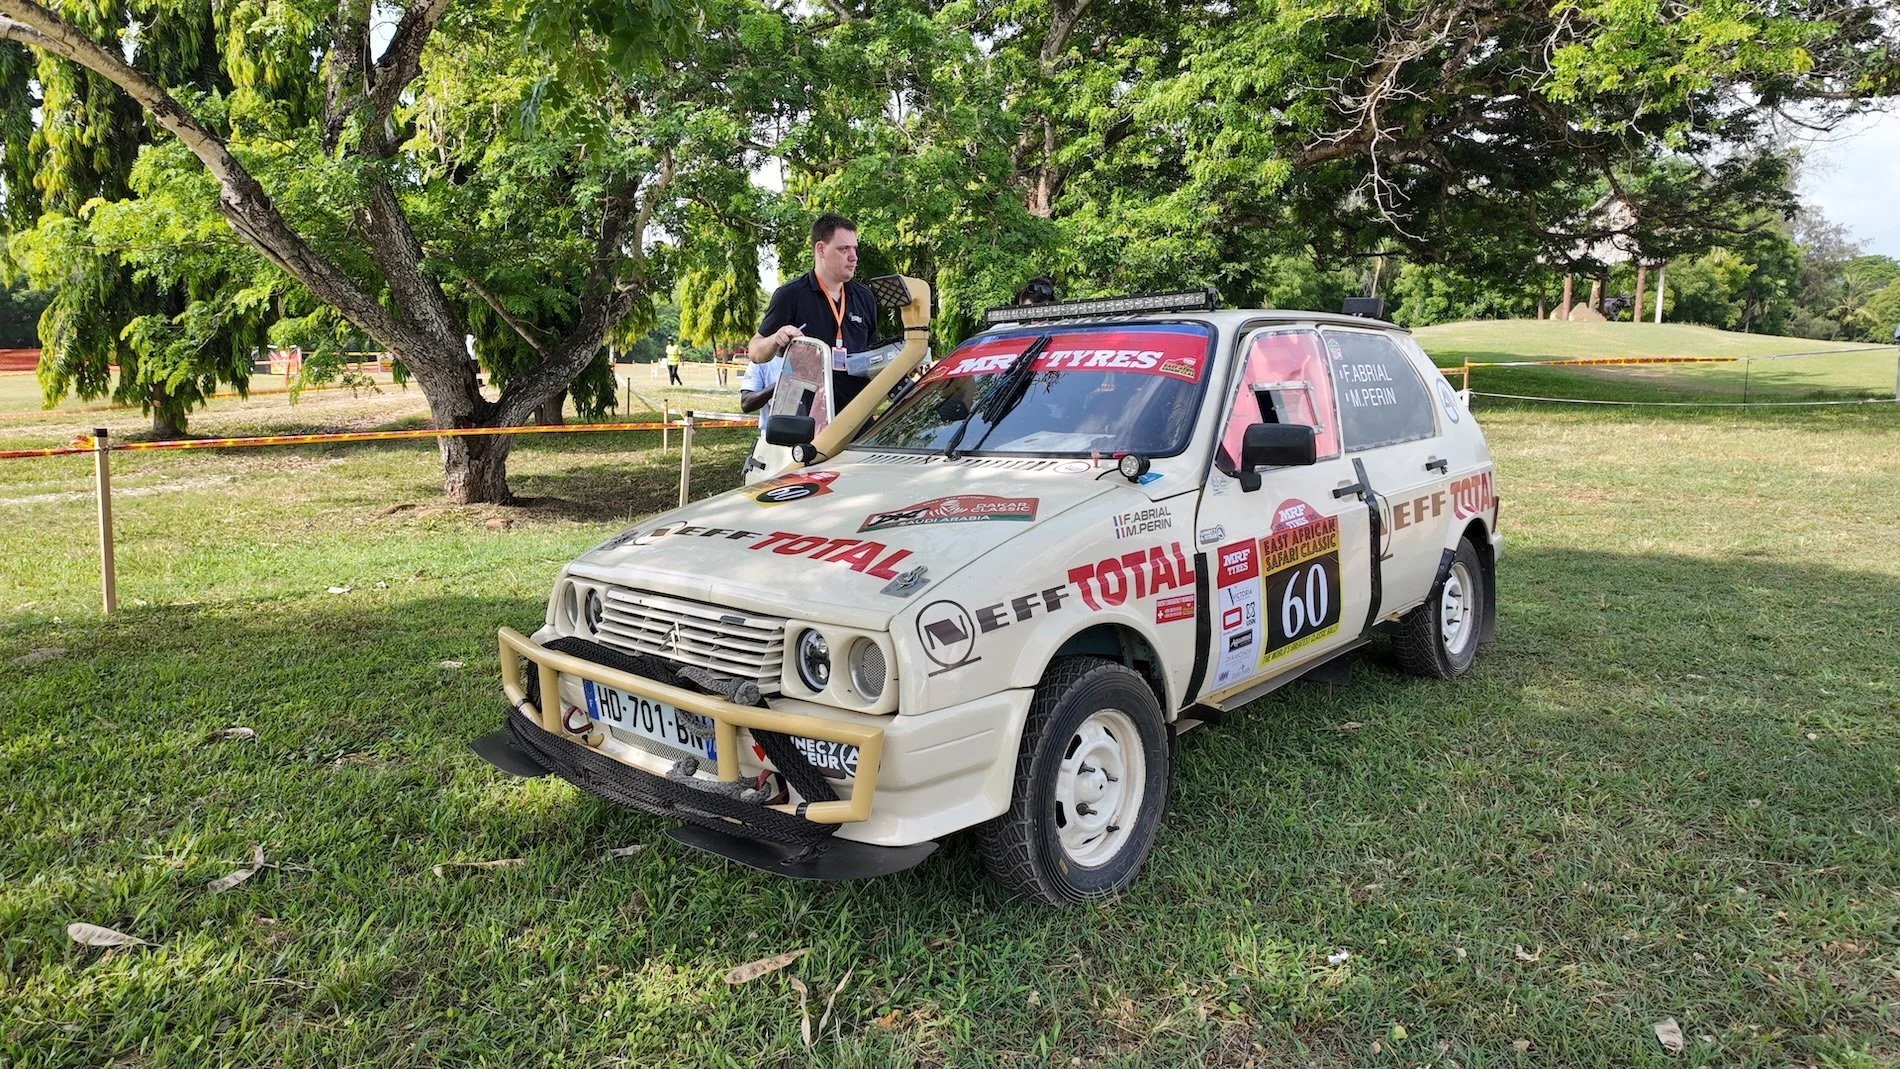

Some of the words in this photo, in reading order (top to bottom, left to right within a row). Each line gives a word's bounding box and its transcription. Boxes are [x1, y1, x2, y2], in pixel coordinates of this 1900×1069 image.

[1047, 349, 1164, 369] TYRES
[1342, 363, 1392, 383] F.ABRIAL
[1349, 387, 1398, 408] M.PERIN
[1449, 471, 1496, 521] TOTAL
[938, 514, 990, 523] ARABIA
[1123, 506, 1172, 525] F.ABRIAL
[1278, 504, 1306, 522] MRF
[1125, 518, 1172, 537] M.PERIN
[1264, 533, 1288, 556] EAST
[1292, 518, 1336, 546] AFRICAN
[747, 531, 915, 581] TOTAL
[1222, 548, 1251, 567] MRF
[1265, 545, 1299, 572] SAFARI
[1300, 533, 1337, 558] CLASSIC
[1067, 541, 1196, 611] TOTAL
[1281, 563, 1329, 639] 60
[800, 750, 841, 770] EUR
